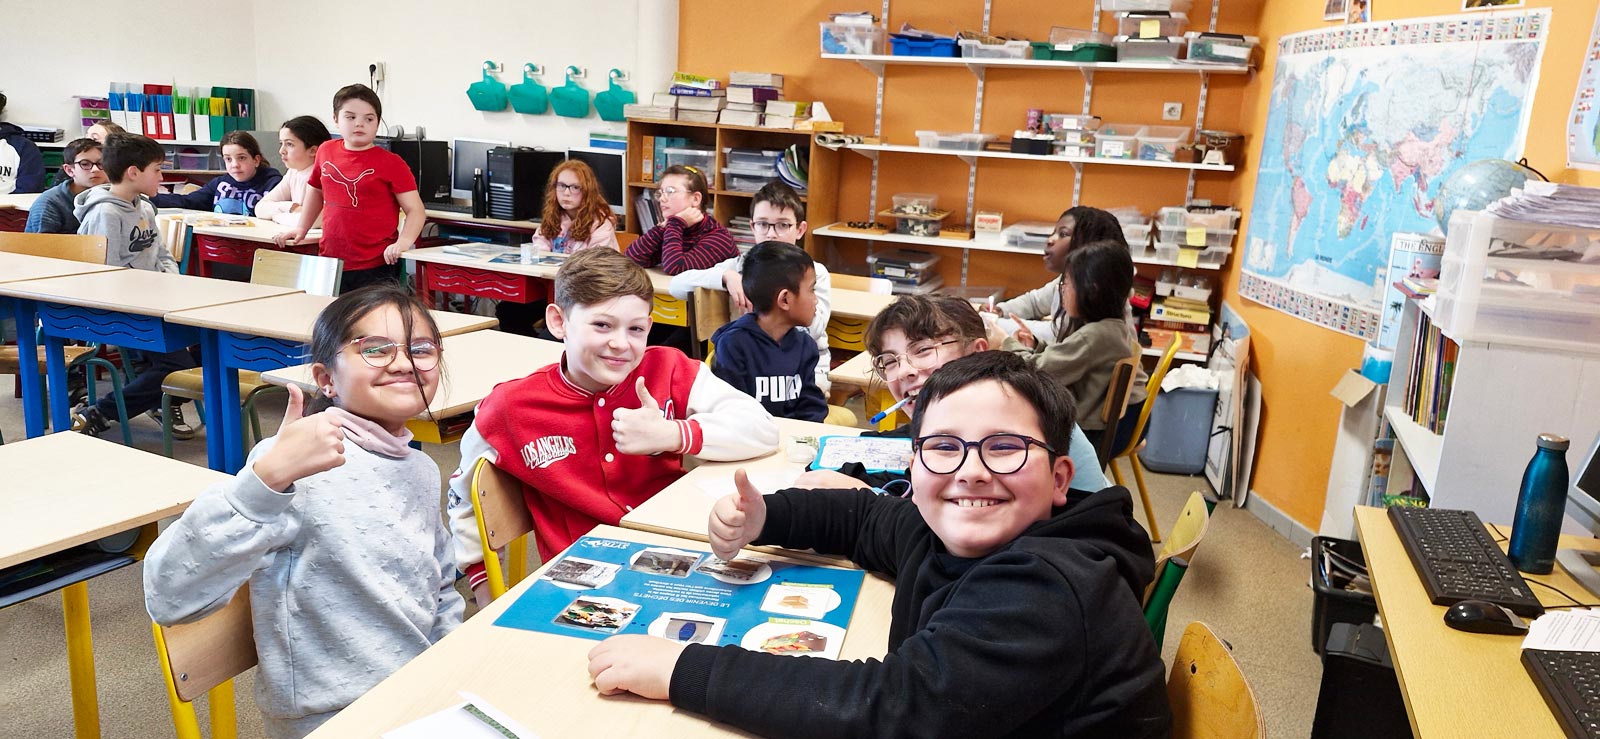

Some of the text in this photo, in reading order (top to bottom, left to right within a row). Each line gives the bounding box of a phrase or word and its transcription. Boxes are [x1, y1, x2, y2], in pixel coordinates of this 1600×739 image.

[213, 181, 269, 208] Stitc
[1418, 241, 1446, 254] ENGL
[520, 435, 577, 467] LOS ANGELES
[685, 599, 719, 607] DEVENIR
